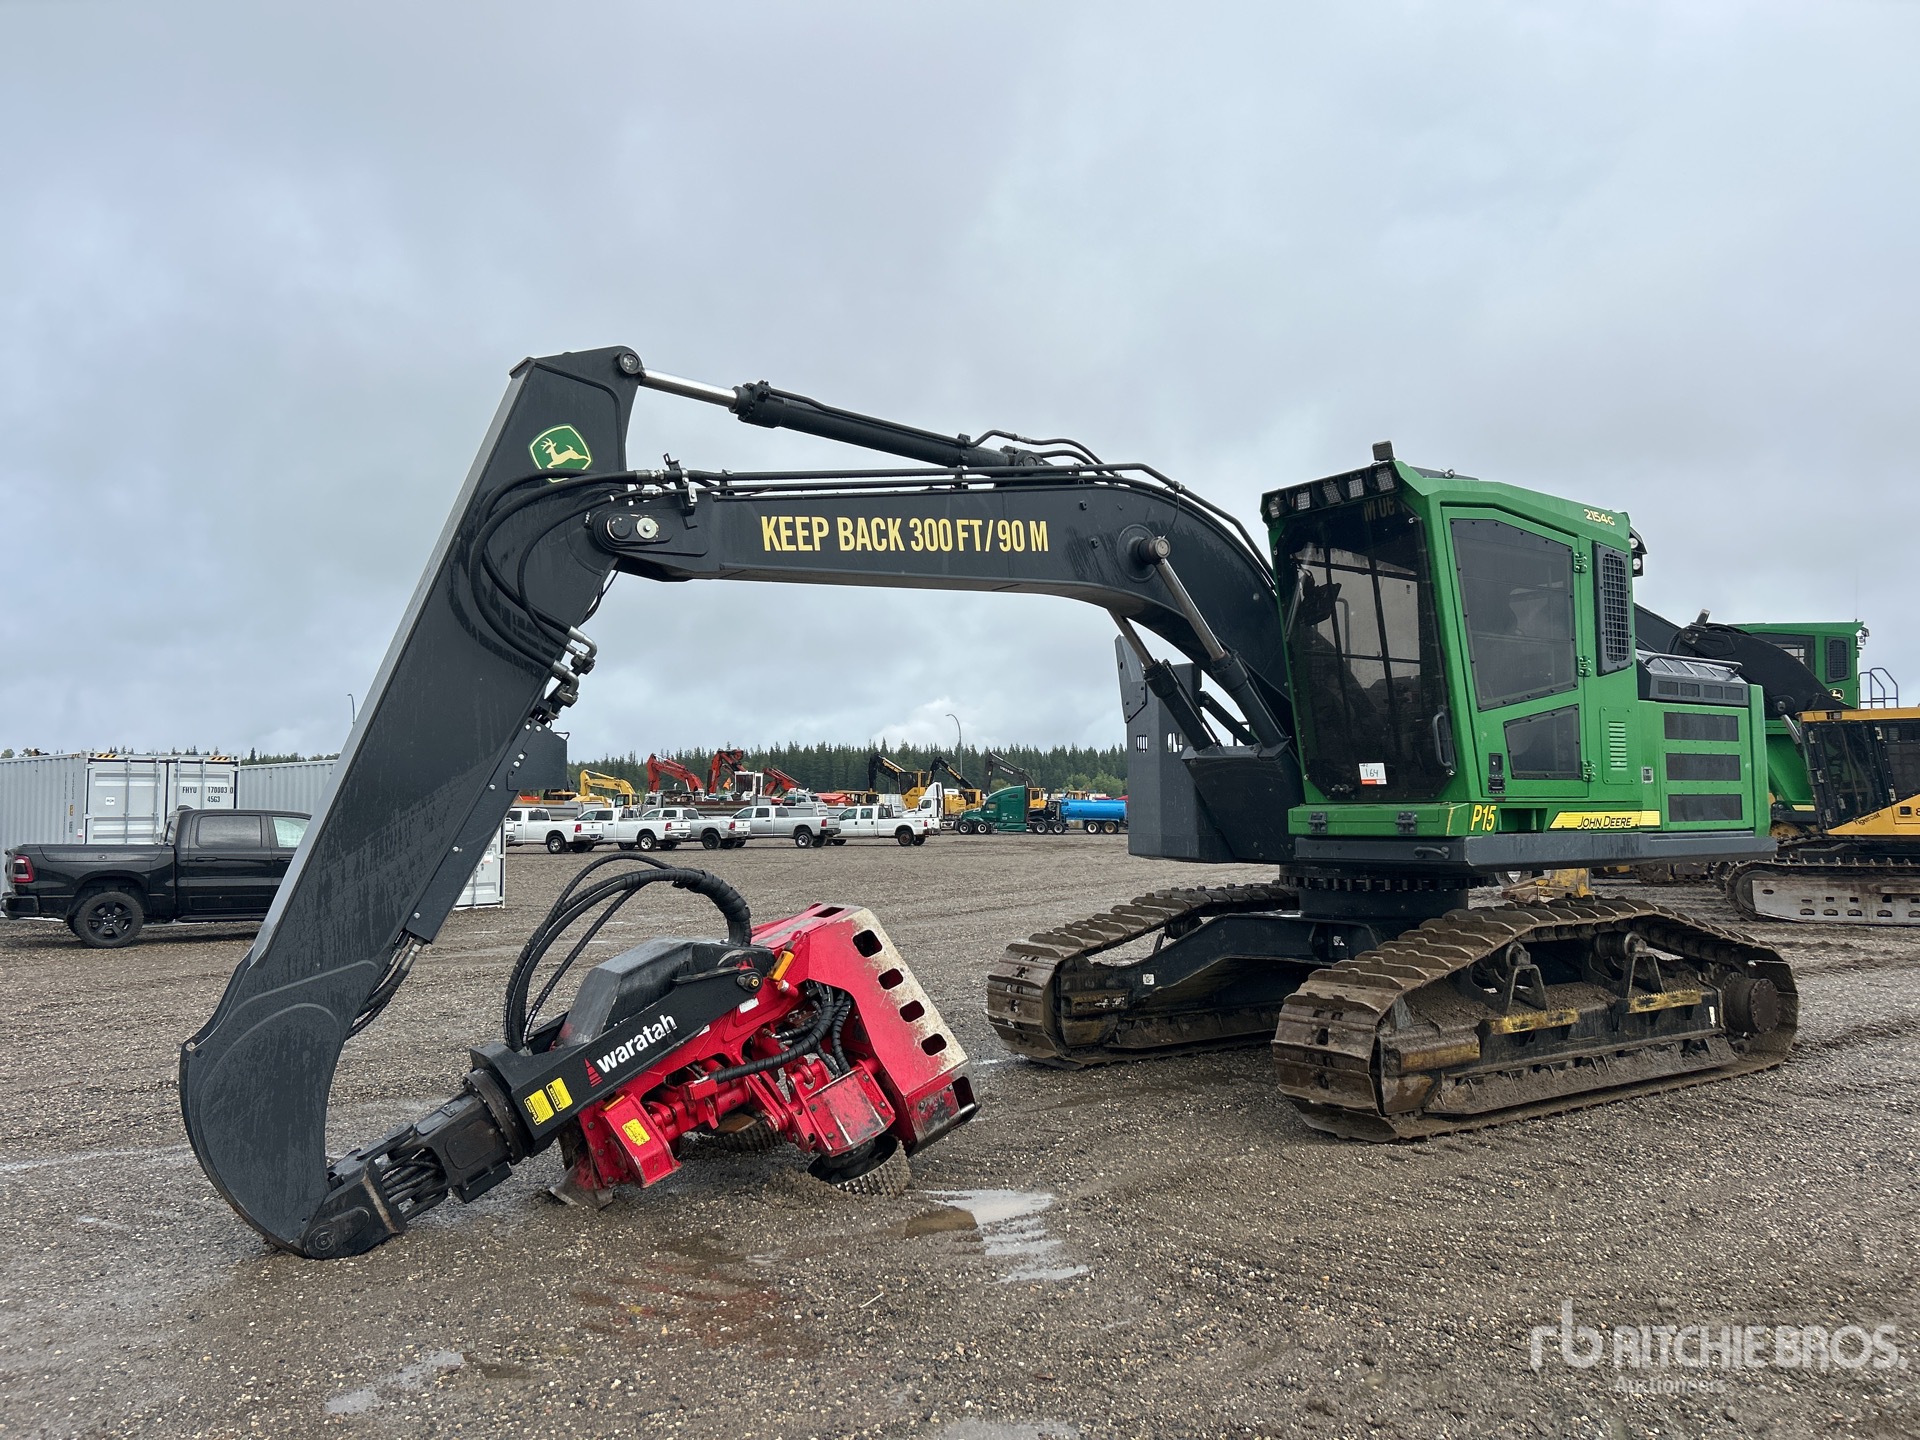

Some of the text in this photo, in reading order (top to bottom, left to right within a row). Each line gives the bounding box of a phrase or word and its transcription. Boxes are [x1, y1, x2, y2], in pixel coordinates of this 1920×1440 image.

[1583, 508, 1616, 526] 2154G
[761, 515, 830, 552] KEEP
[836, 517, 906, 552] BACK
[909, 517, 953, 552] 300
[1029, 520, 1049, 552] M
[1365, 768, 1379, 778] 164
[1470, 804, 1497, 832] P15
[1577, 815, 1632, 828] JOHN DEERE
[1854, 812, 1881, 826] Tigercat
[596, 1014, 678, 1074] waratah
